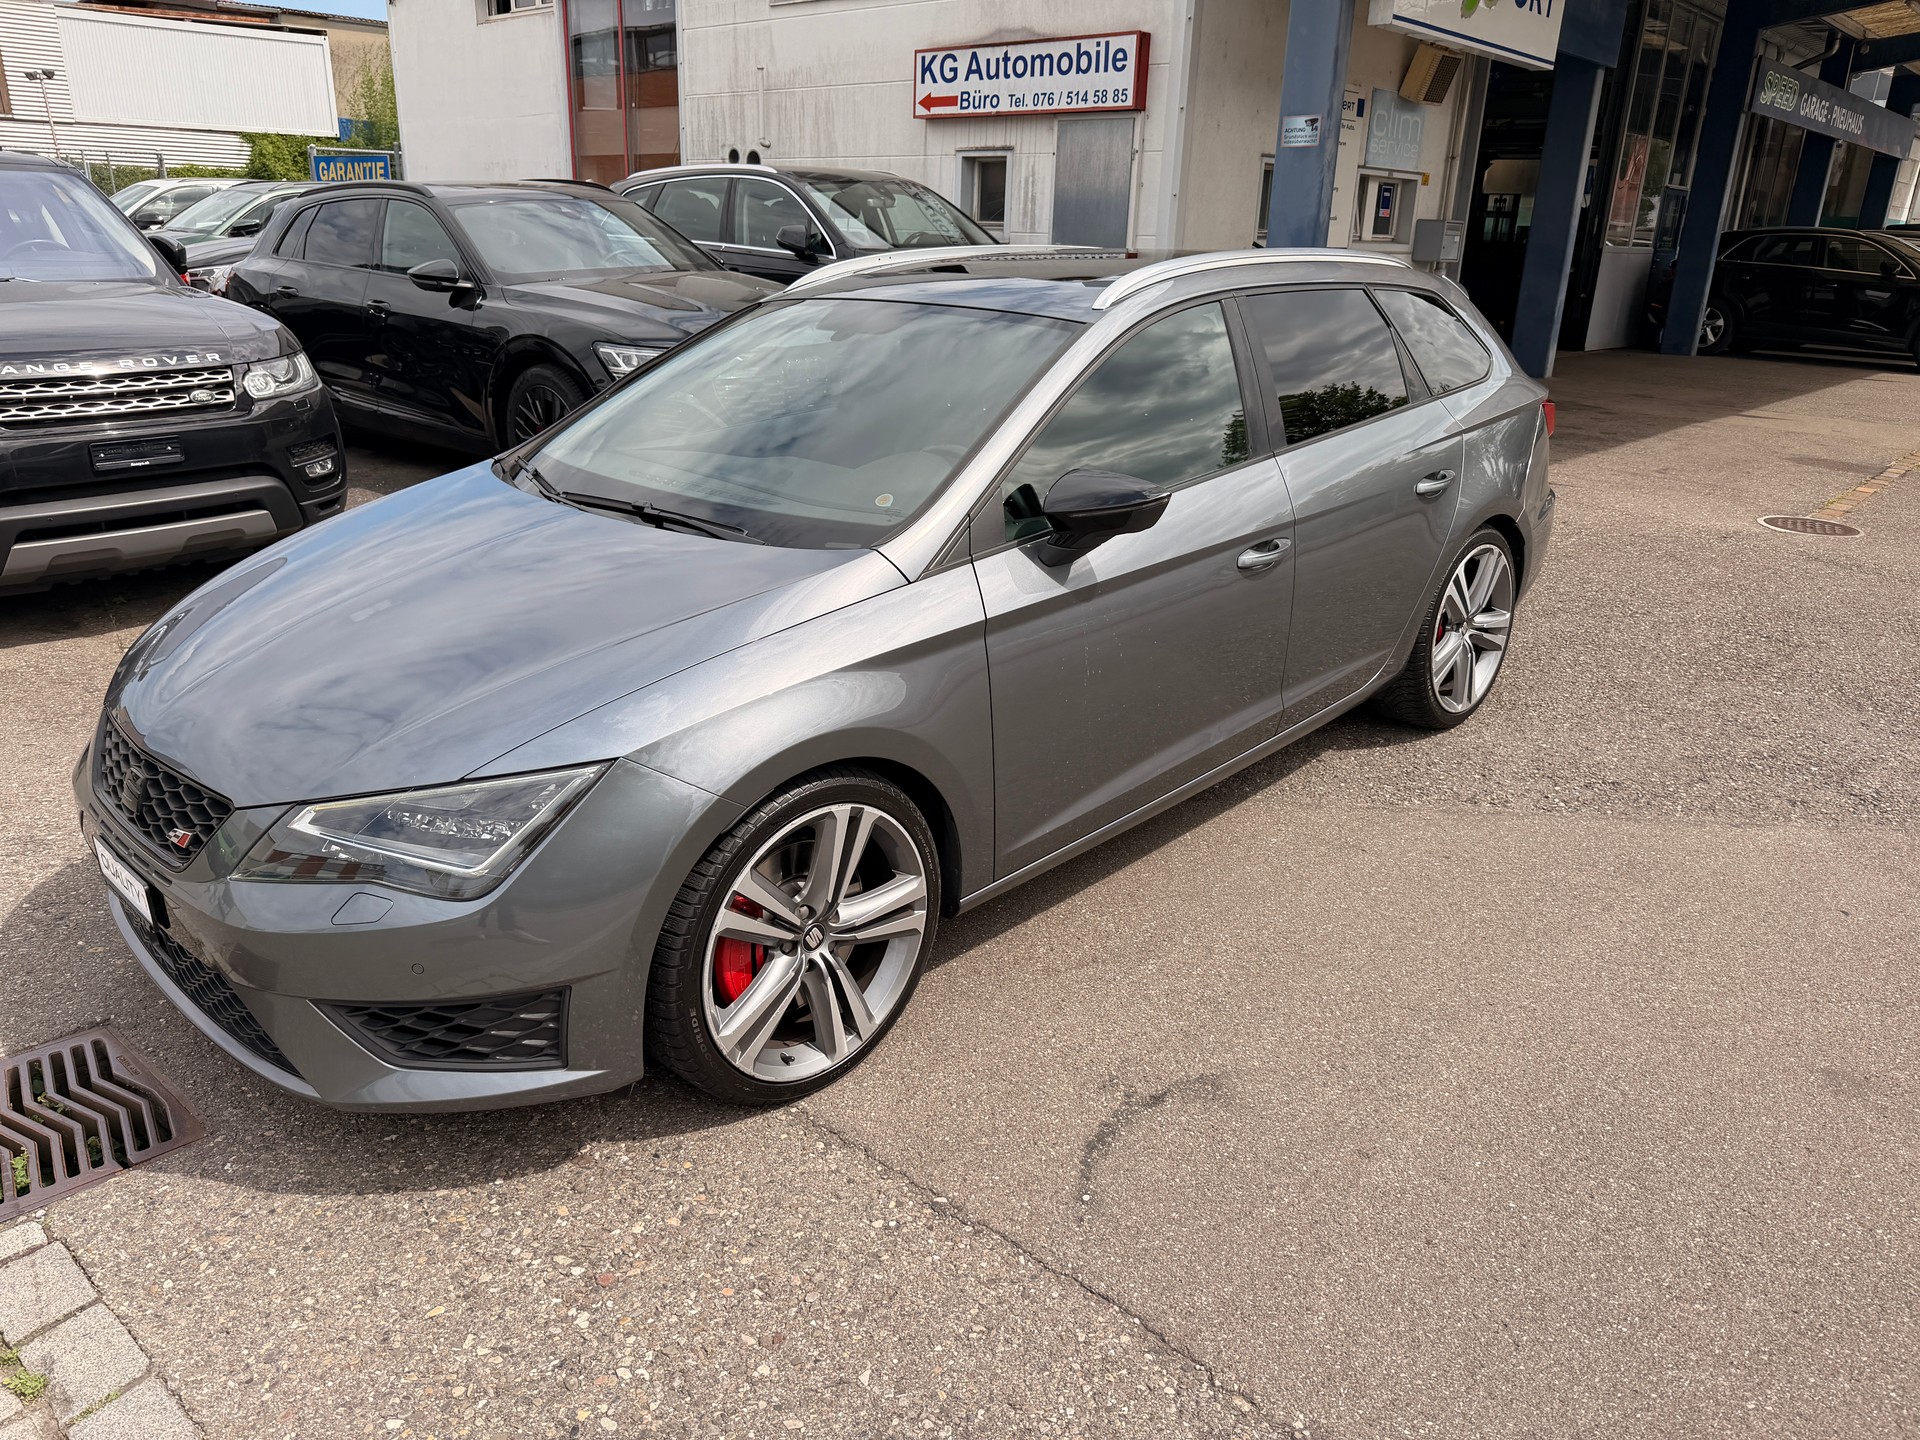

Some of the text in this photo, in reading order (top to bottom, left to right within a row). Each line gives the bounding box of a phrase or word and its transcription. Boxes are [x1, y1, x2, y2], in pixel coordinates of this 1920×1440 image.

[920, 40, 1128, 85] KG Automobile
[959, 89, 1000, 111] Büro
[1008, 93, 1028, 108] Tel.
[1032, 92, 1055, 107] 076
[1066, 89, 1090, 106] 514
[1093, 88, 1108, 104] 58
[1112, 88, 1128, 103] 85
[1759, 70, 1800, 112] SPEED
[1800, 92, 1830, 123] GARAGE
[1830, 105, 1865, 135] PNEUHAUS
[1373, 102, 1421, 143] clim
[1371, 138, 1419, 159] service
[318, 161, 385, 181] GARANTIE
[0, 353, 222, 375] ANGE ROVER
[101, 853, 141, 904] QUALITY
